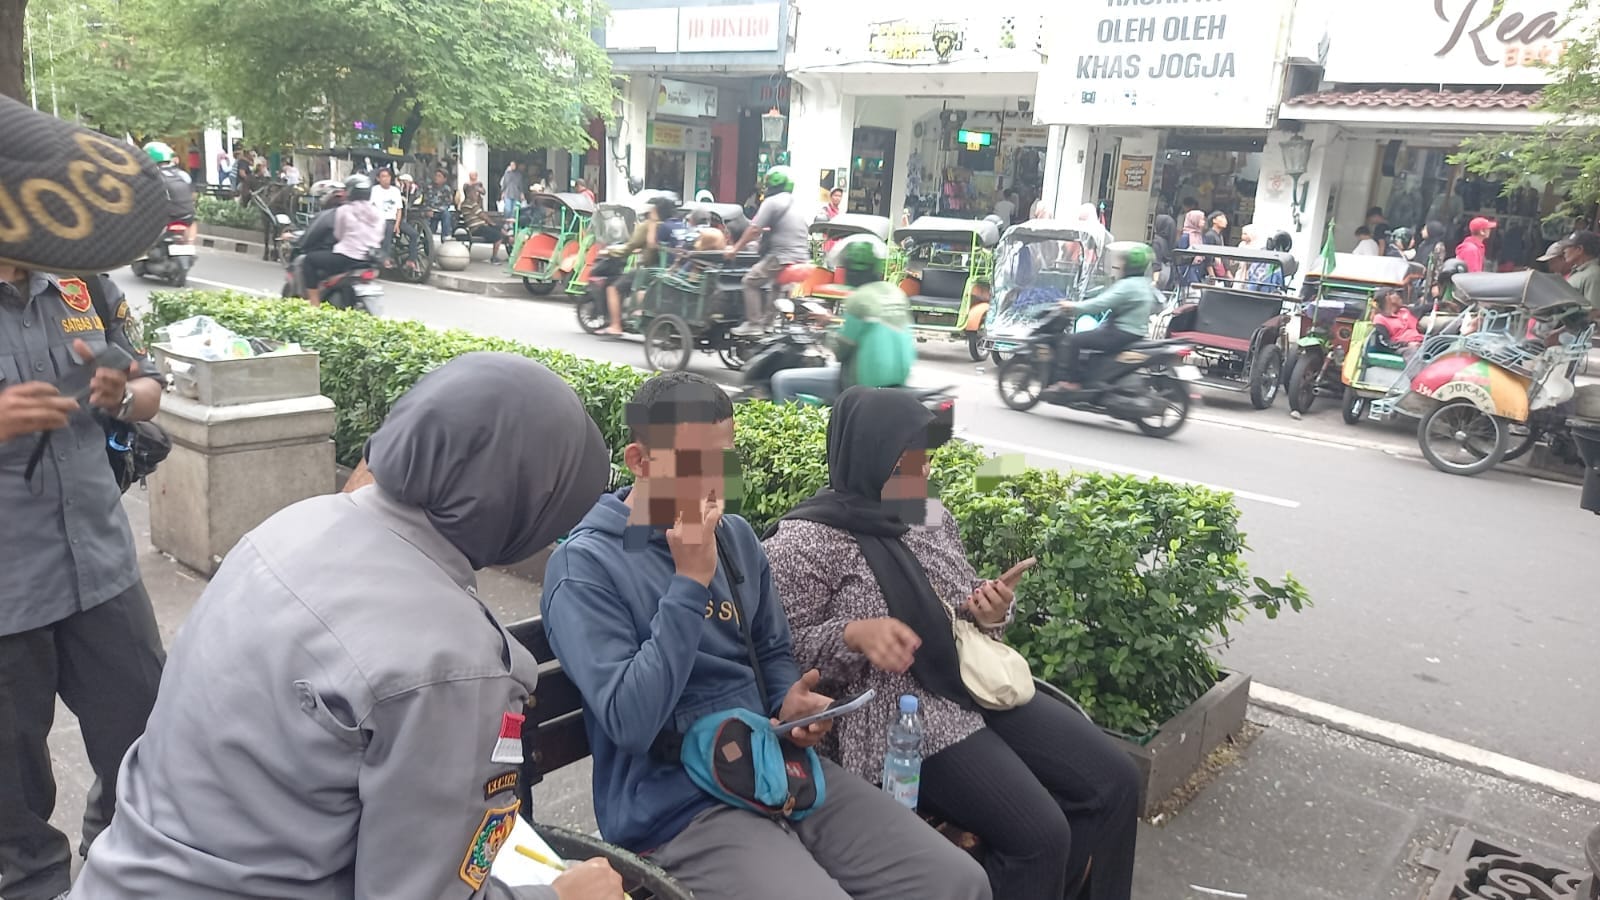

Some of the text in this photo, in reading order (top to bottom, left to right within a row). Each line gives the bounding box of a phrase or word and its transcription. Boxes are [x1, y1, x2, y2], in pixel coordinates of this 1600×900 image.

[1097, 14, 1227, 43] OLEH OLEH
[1076, 52, 1236, 79] KHAS JOGJA
